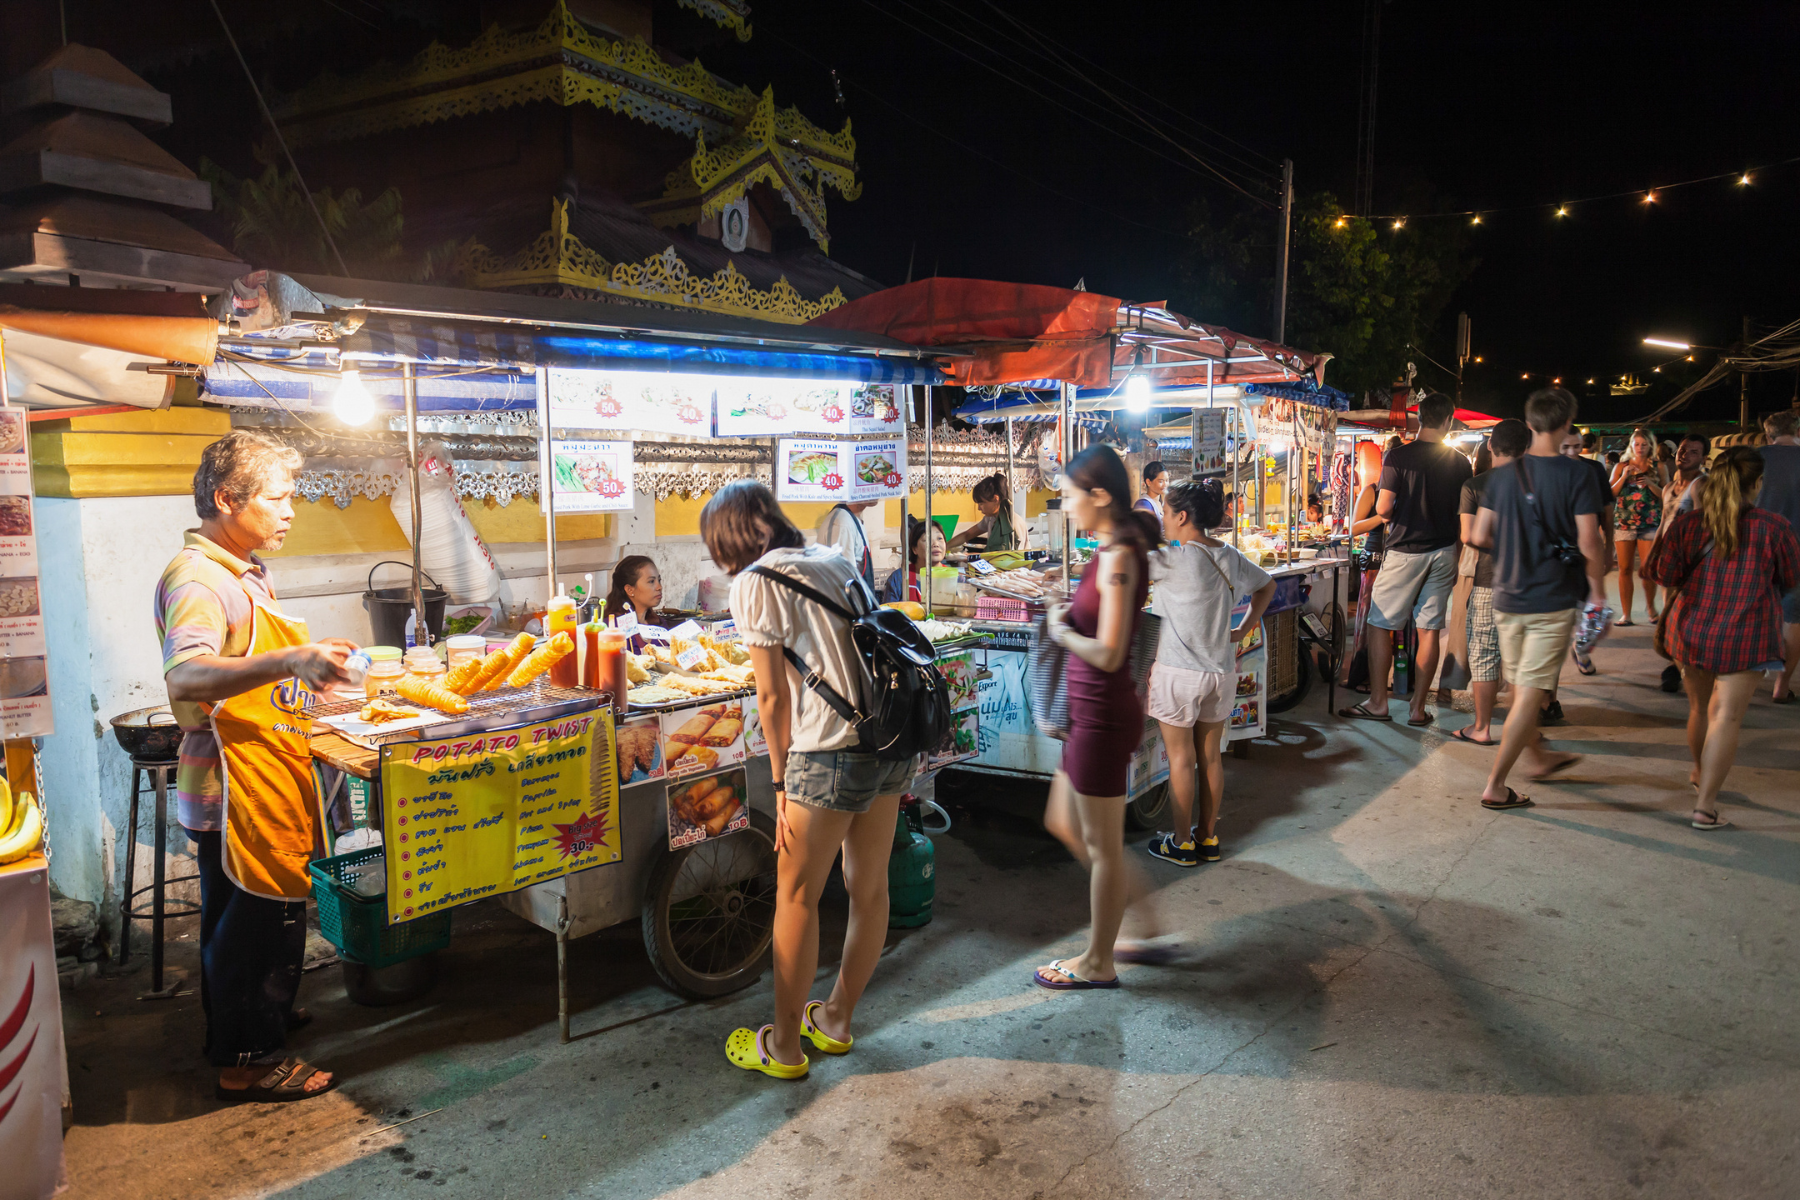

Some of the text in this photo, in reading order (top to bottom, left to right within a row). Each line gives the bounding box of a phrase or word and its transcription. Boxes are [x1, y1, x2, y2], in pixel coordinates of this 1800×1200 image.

[825, 475, 840, 487] 40.
[886, 474, 900, 486] 40.
[602, 481, 621, 494] 50.
[412, 716, 593, 763] POTATO TWIST
[568, 820, 598, 835] Big size
